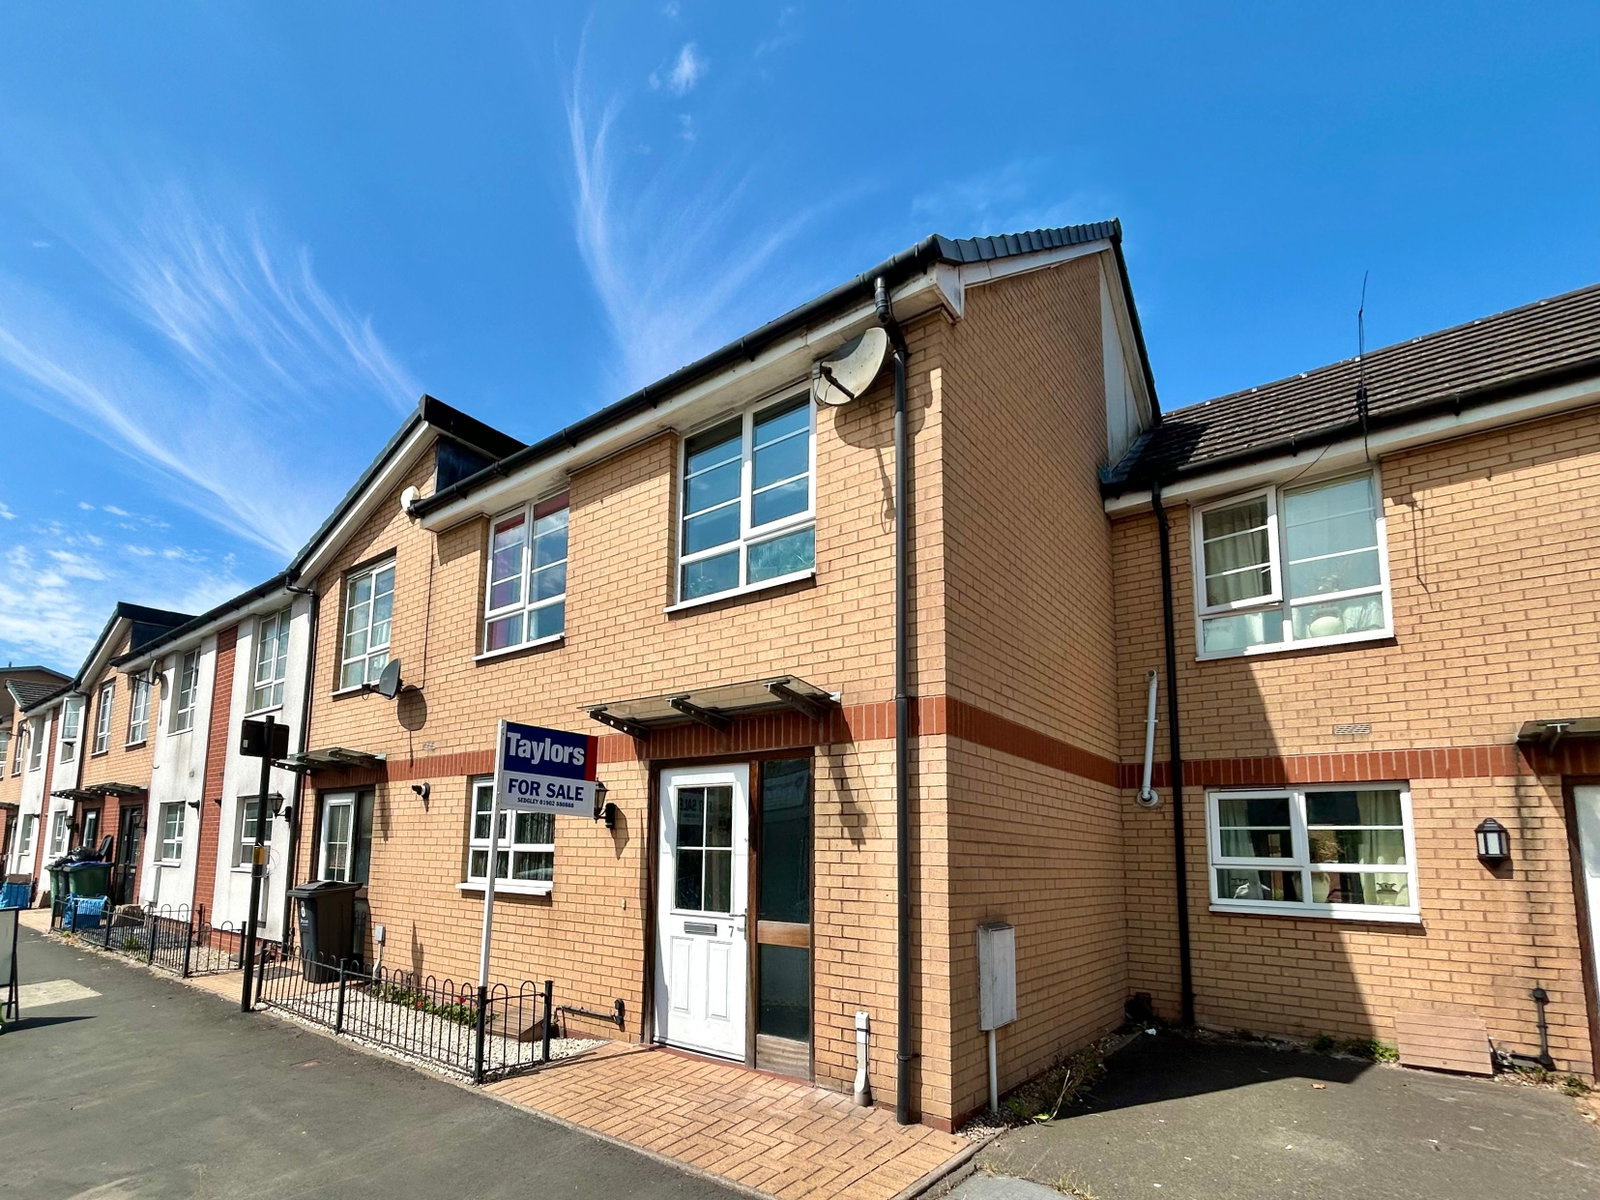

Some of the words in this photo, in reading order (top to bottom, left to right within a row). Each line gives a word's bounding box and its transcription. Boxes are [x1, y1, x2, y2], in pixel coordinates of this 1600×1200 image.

[507, 732, 585, 765] Taylors
[508, 778, 541, 796] FOR
[546, 783, 584, 801] SALE
[728, 925, 735, 939] 7
